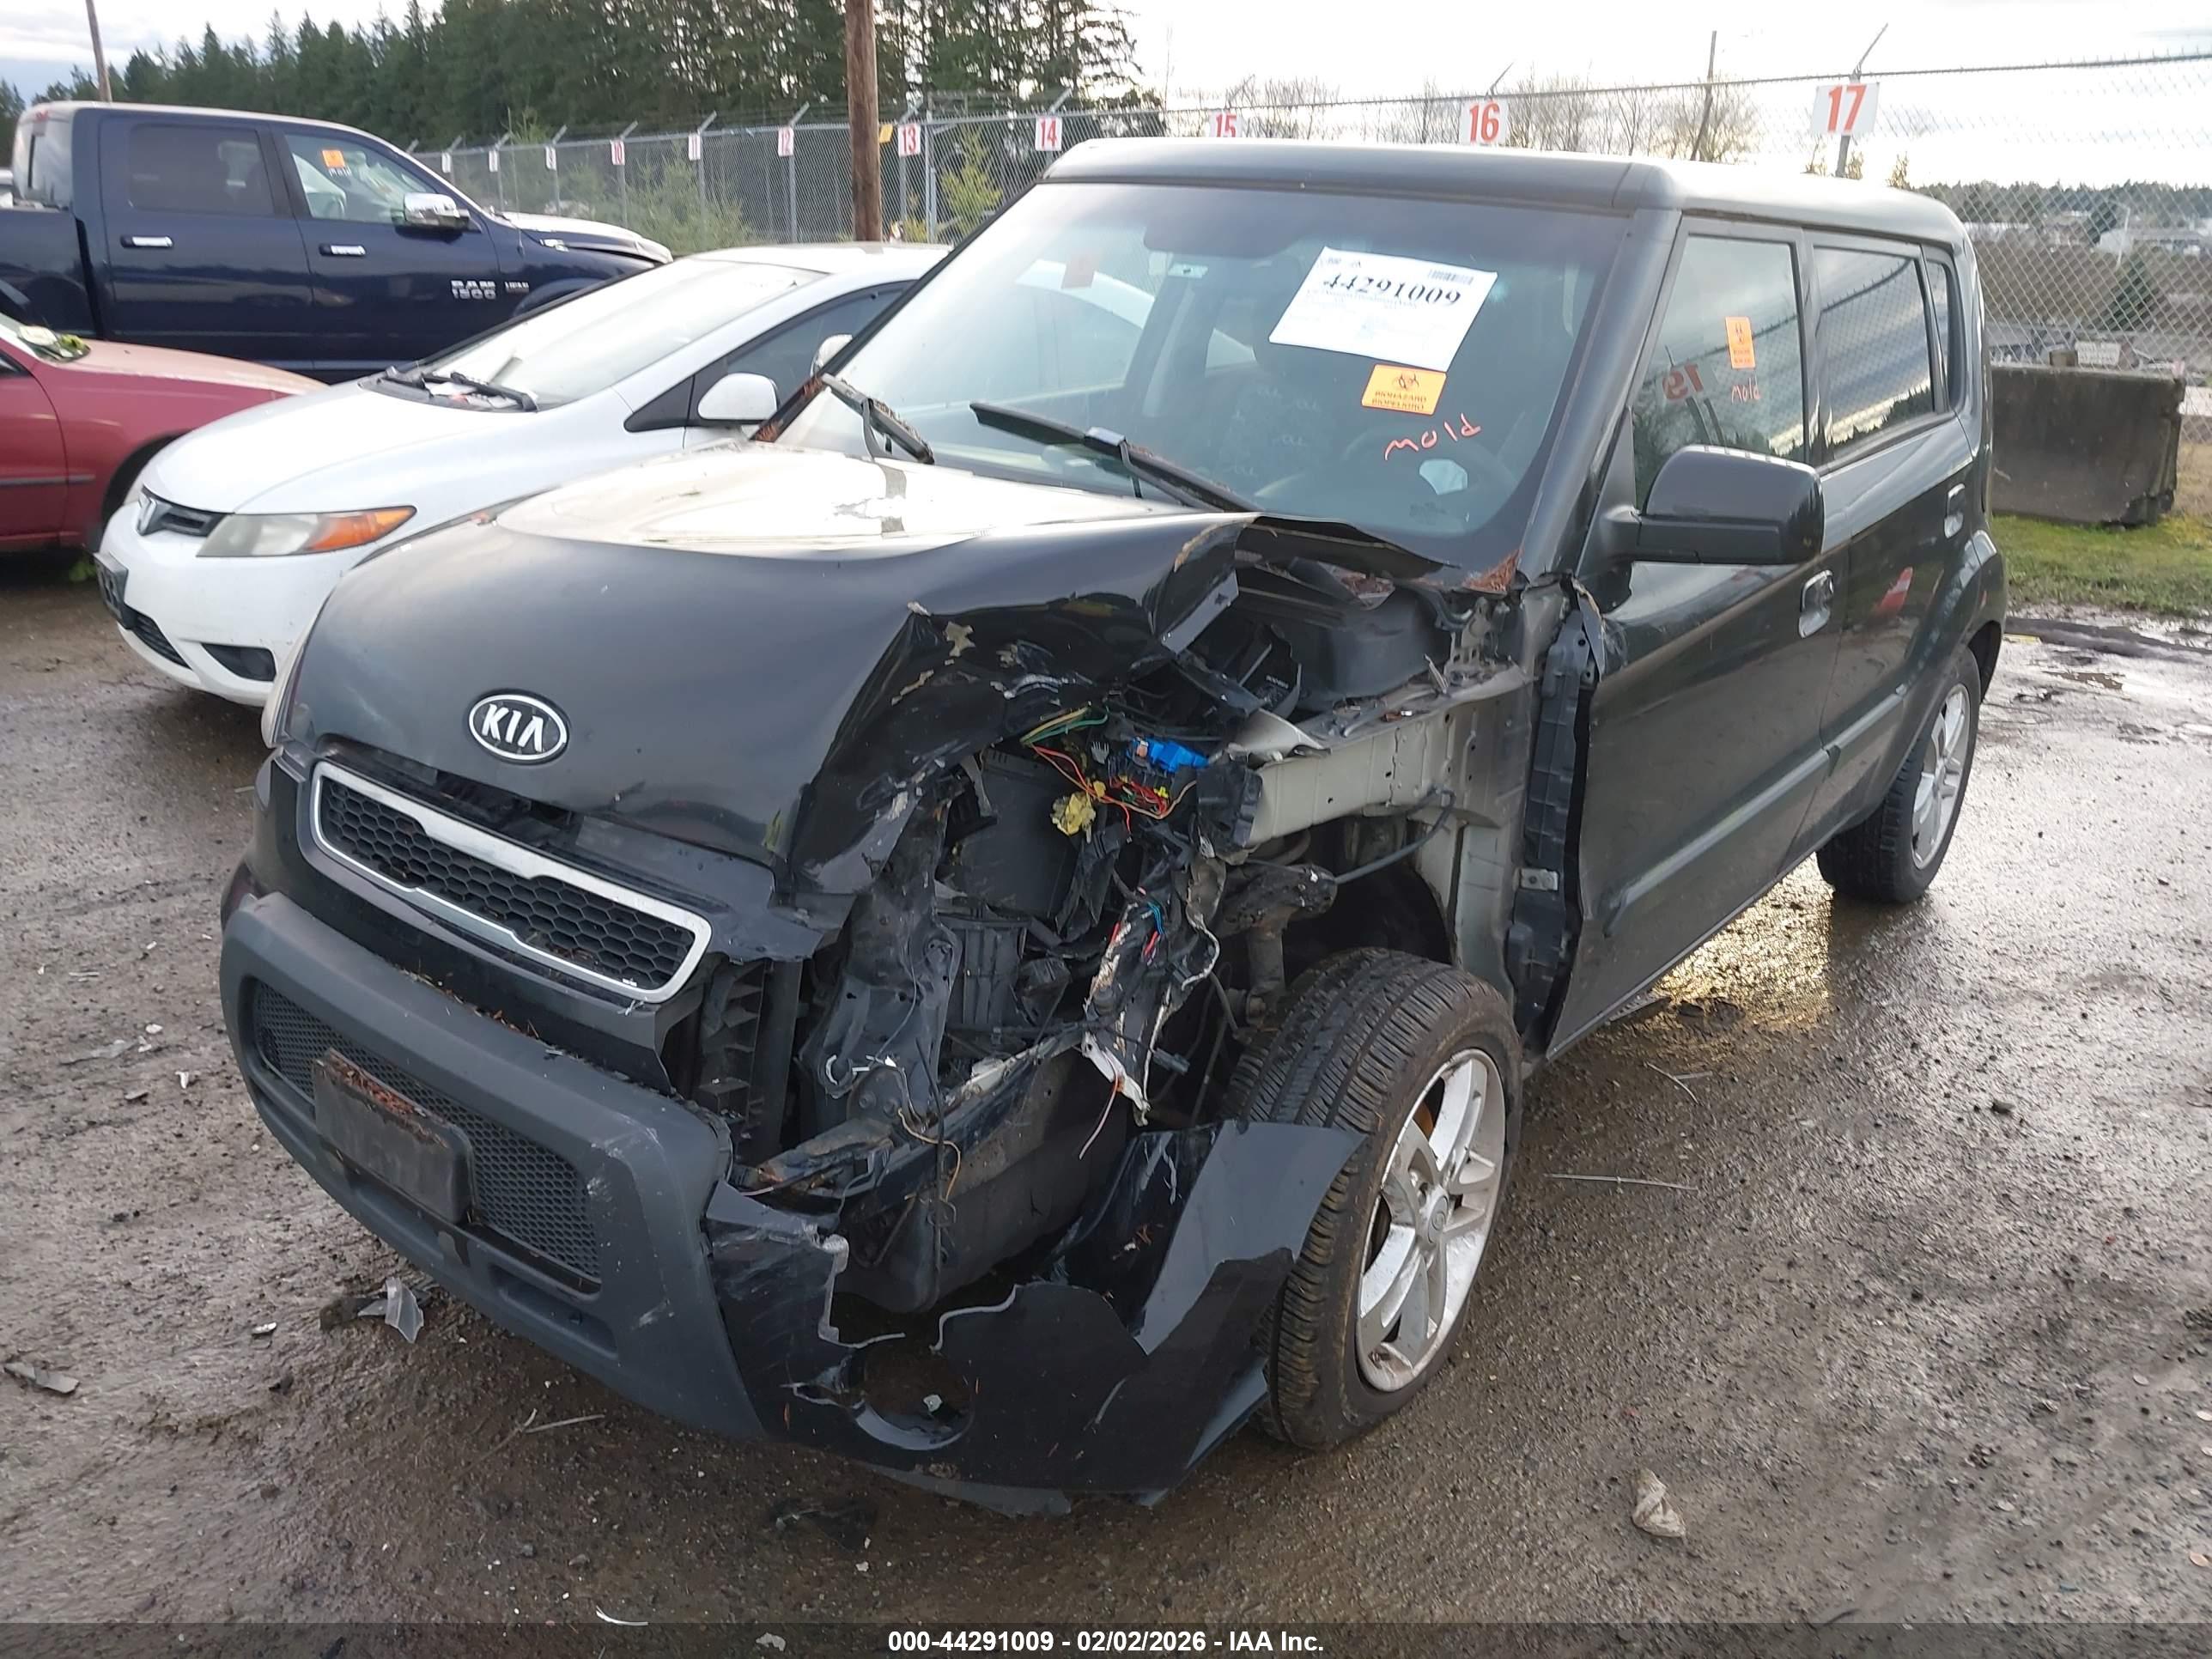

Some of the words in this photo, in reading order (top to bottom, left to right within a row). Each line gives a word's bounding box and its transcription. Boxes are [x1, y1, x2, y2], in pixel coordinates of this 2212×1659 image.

[1828, 85, 1866, 131] 17
[1041, 119, 1057, 148] 14
[1216, 113, 1237, 137] 15
[1470, 103, 1499, 142] 16
[782, 131, 793, 154] 12
[902, 125, 916, 152] 13
[614, 142, 623, 164] 10
[451, 281, 495, 289] RAM
[1322, 273, 1462, 303] 44291009
[481, 703, 544, 752] KIA
